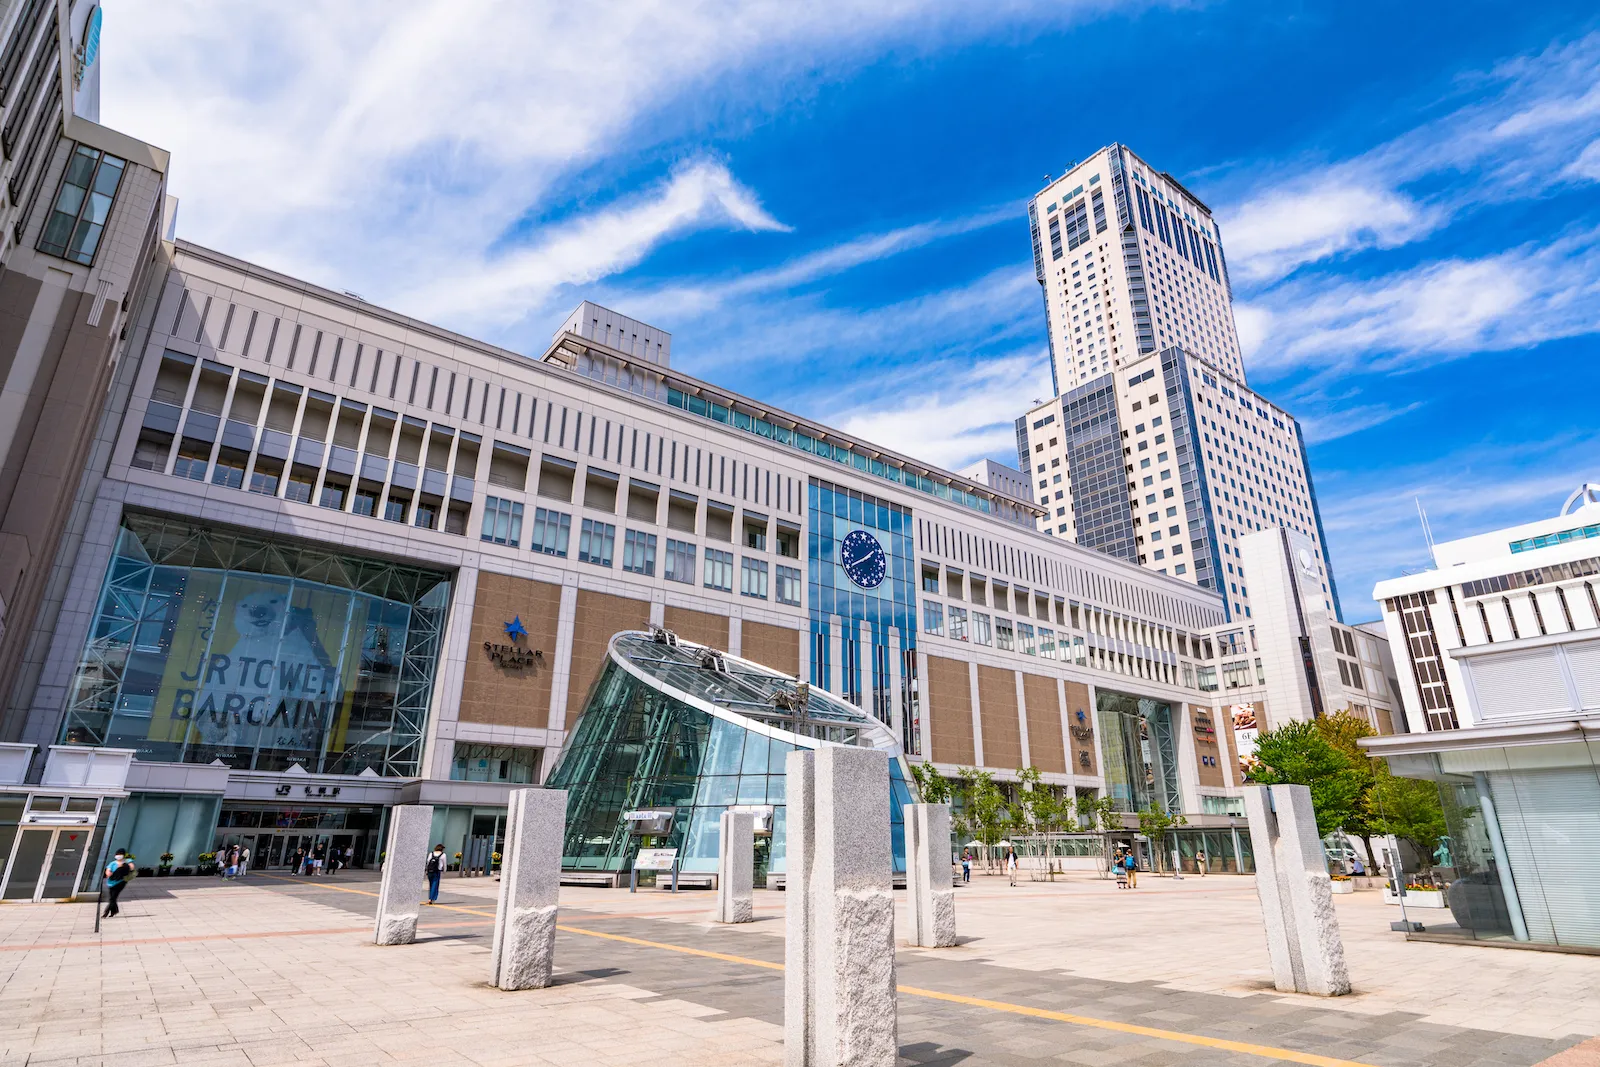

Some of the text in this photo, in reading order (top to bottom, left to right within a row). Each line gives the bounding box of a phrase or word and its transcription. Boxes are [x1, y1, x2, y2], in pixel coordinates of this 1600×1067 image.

[483, 641, 543, 658] STELLAR
[491, 652, 534, 666] PLACE
[180, 652, 231, 685] JR
[170, 688, 327, 729] BARGAIN
[275, 785, 291, 793] JR
[304, 786, 341, 795] 札幌駅
